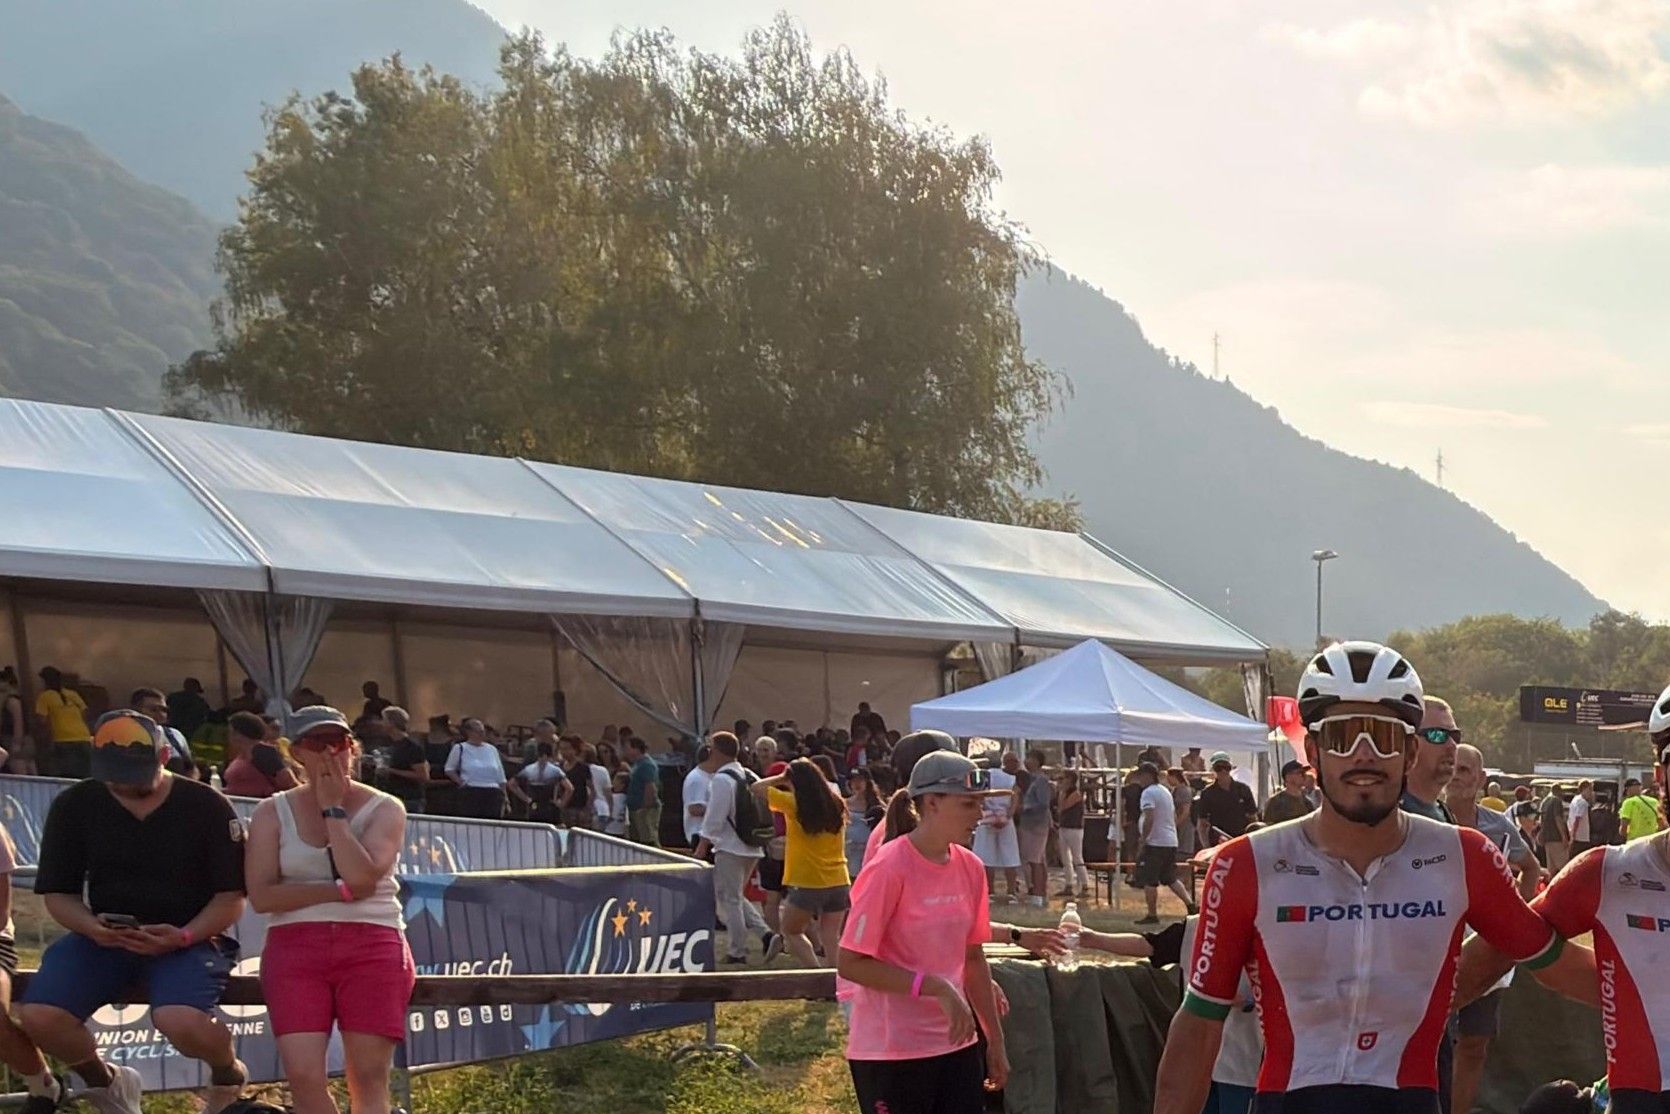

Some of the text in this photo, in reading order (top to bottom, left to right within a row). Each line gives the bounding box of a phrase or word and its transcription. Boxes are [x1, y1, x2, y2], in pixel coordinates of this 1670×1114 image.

[1192, 856, 1235, 988] PORTUGAL
[1308, 900, 1446, 922] PORTUGAL
[637, 929, 710, 974] UEC
[1602, 959, 1618, 1065] PORTUGAL
[96, 1028, 147, 1046] NION
